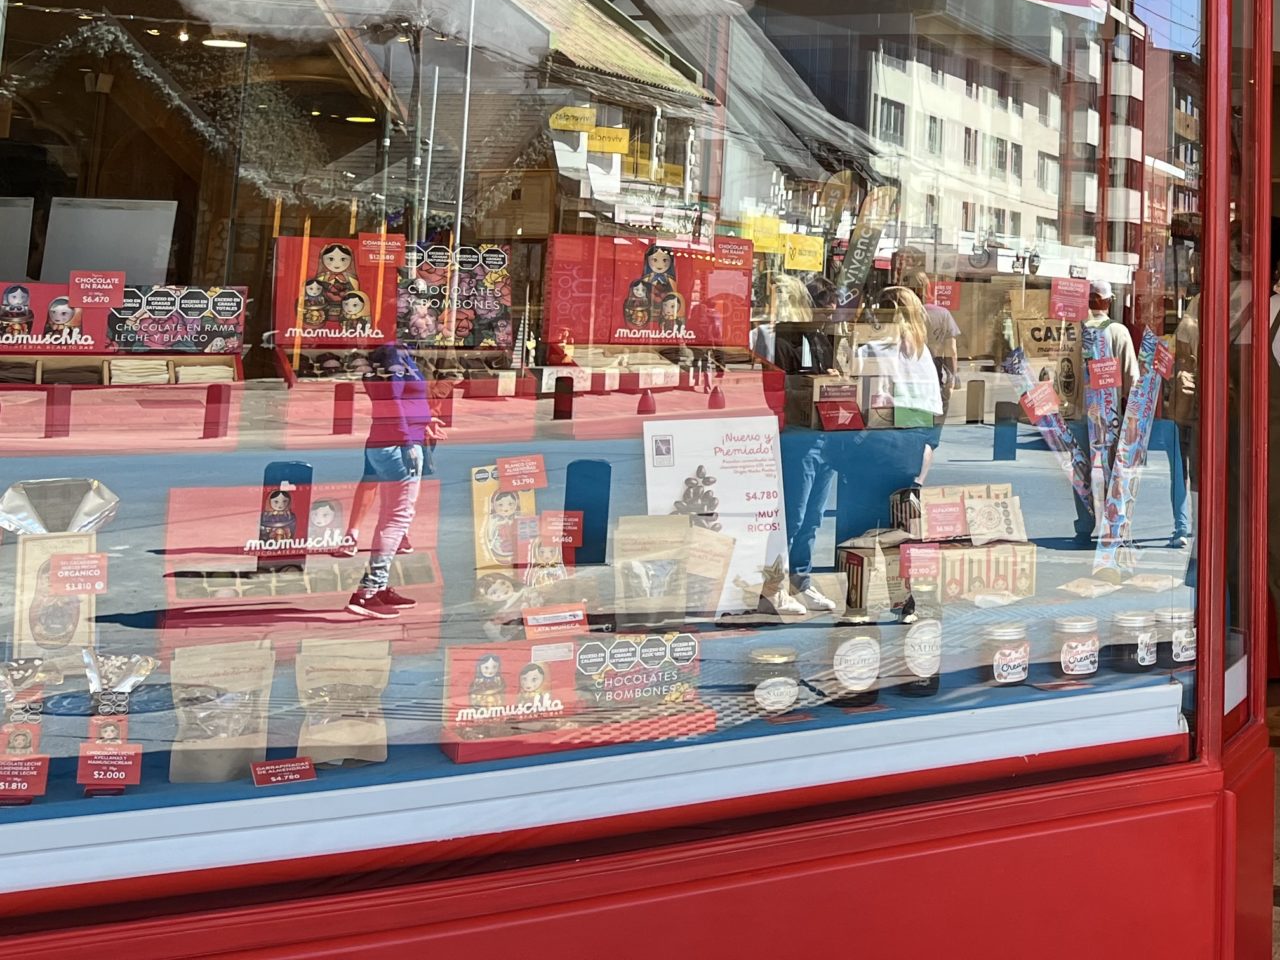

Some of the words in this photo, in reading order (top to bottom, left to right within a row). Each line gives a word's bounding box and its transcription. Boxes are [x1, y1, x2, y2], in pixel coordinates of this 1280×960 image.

[75, 277, 120, 285] CHOCOLATE
[82, 295, 110, 304] $6.470
[115, 323, 183, 332] CHOCOLATE
[187, 323, 201, 332] EN
[205, 324, 236, 332] RAMA
[284, 323, 385, 339] mamuschka
[614, 324, 697, 339] mamuschka
[1030, 323, 1077, 342] CAFÉ
[0, 326, 95, 344] amuschka
[114, 333, 151, 342] LECHE
[153, 333, 162, 342] Y
[163, 334, 208, 342] BLANCO
[713, 444, 773, 457] Premiado!
[745, 490, 778, 501] $4.780
[754, 509, 779, 522] ¡MUY
[747, 522, 780, 533] RICOS!
[244, 528, 355, 552] mamuschka
[595, 670, 678, 689] CHOCOLATES
[594, 692, 602, 702] Y
[606, 684, 678, 701] BOMBONES
[455, 694, 565, 722] mamuschka
[93, 770, 126, 780] $2.000
[0, 782, 28, 790] $1.810
